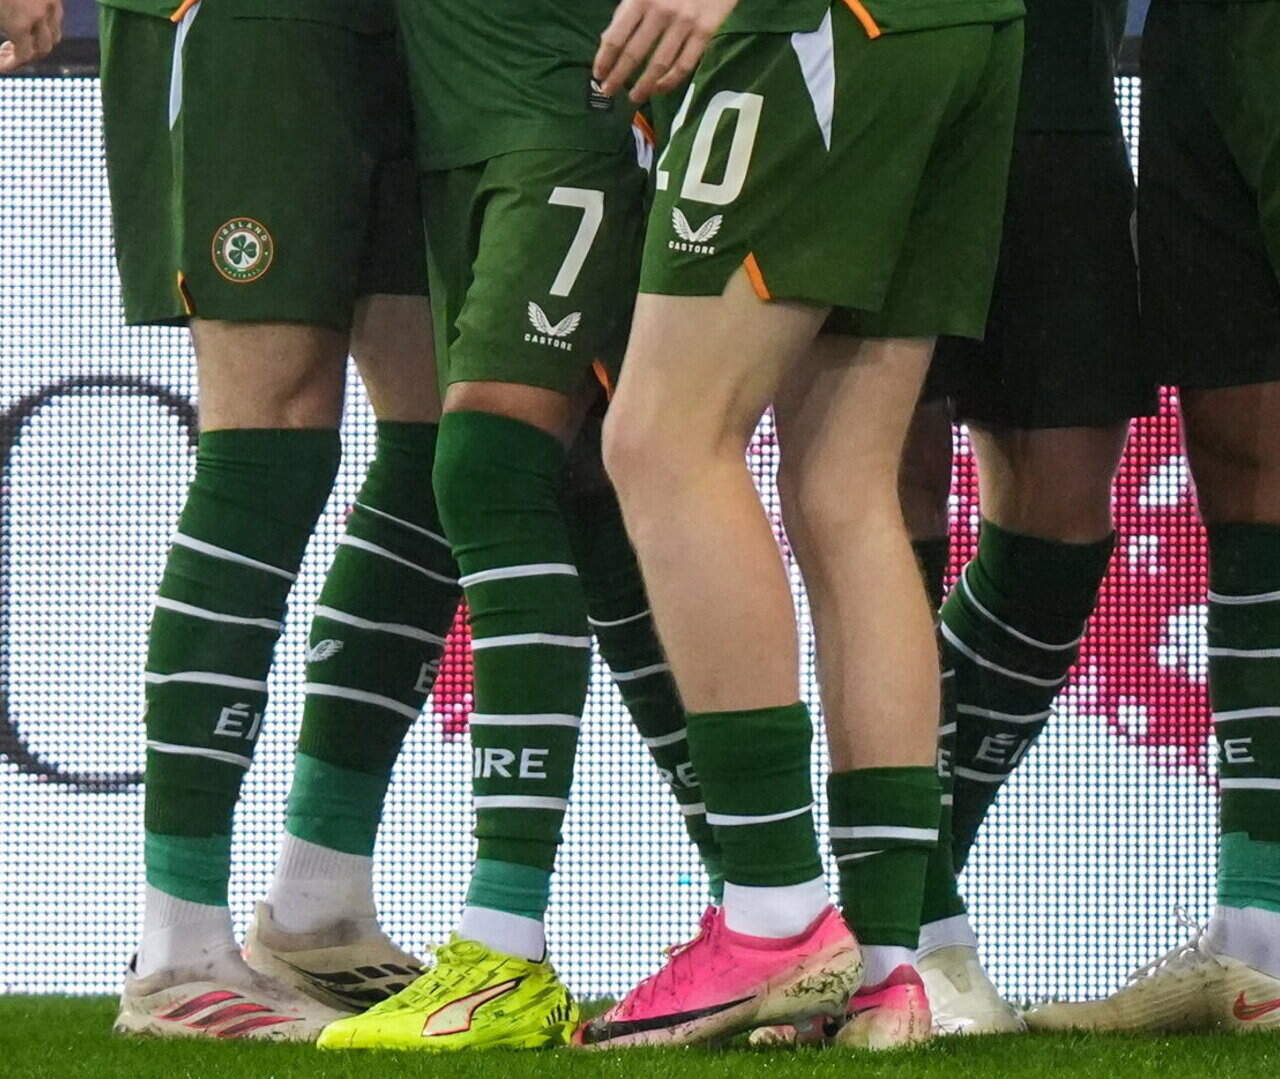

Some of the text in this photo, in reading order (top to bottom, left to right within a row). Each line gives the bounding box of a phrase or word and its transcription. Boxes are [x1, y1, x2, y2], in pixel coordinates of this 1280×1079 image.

[547, 186, 605, 297] 7
[668, 240, 715, 255] CASTORE
[524, 333, 573, 351] CASTORE
